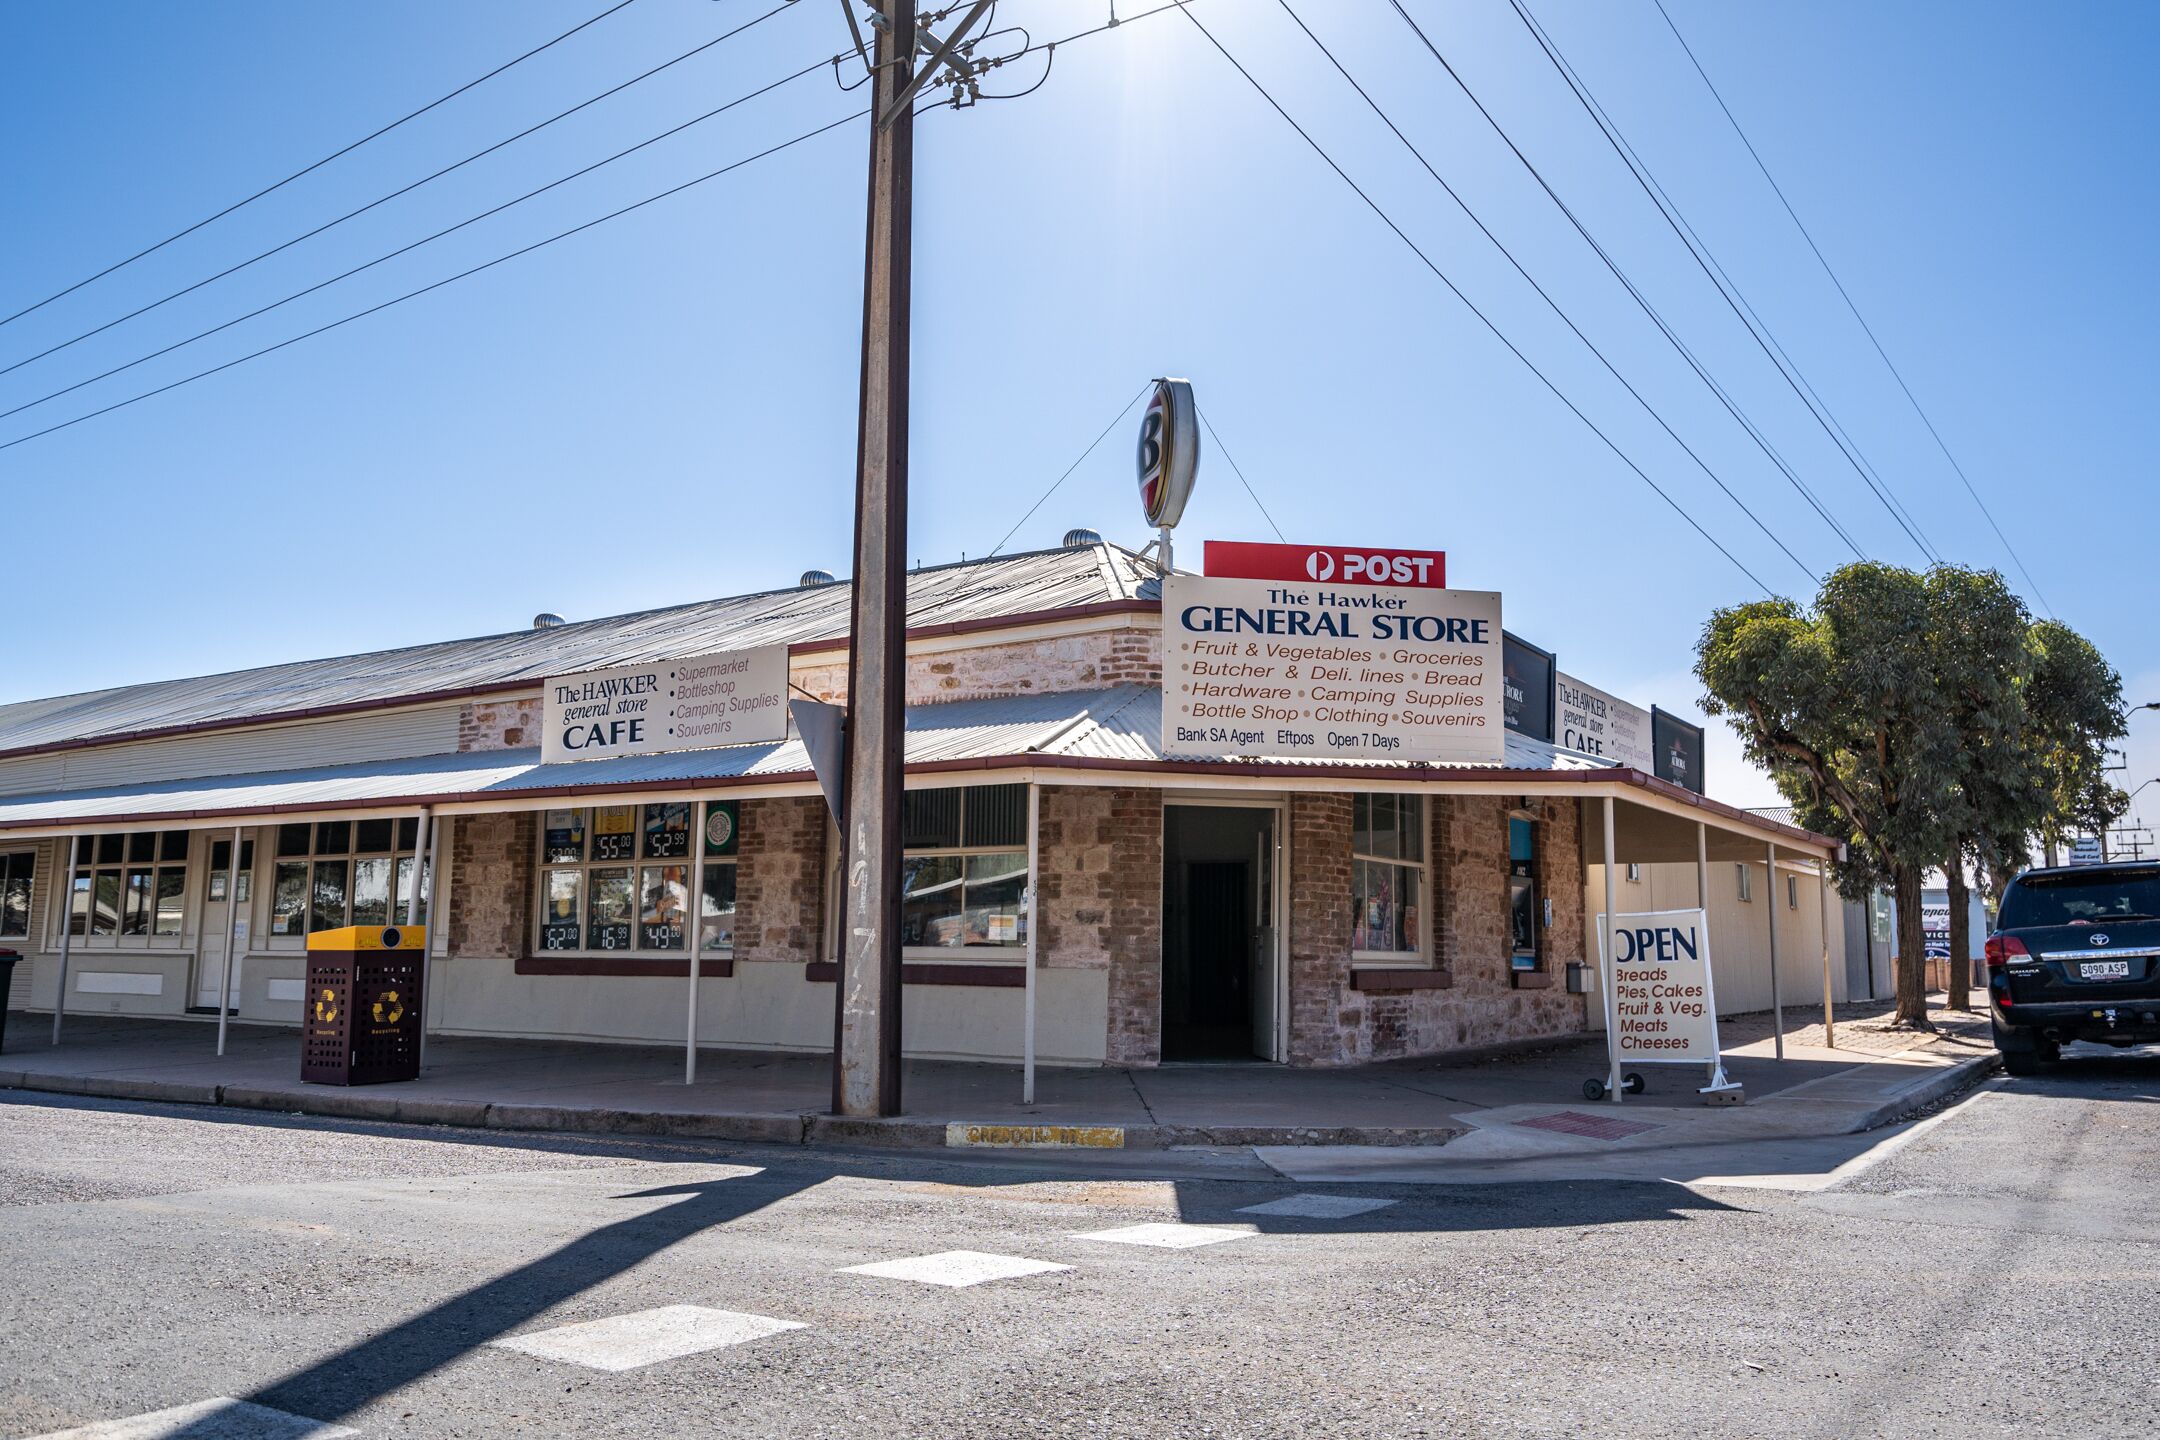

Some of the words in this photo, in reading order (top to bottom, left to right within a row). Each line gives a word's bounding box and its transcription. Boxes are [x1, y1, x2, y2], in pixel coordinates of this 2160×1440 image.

[1344, 554, 1434, 584] POST
[1266, 589, 1308, 606] The
[1318, 592, 1407, 610] Hawker
[1181, 606, 1359, 638] GENERAL
[1372, 614, 1488, 644] STORE
[1193, 640, 1239, 656] Fruit
[1246, 643, 1258, 657] &
[1266, 644, 1372, 663] Vegetables
[1394, 650, 1484, 666] Groceries
[678, 658, 749, 682] Supermarket
[1192, 661, 1274, 678] Butcher
[1286, 666, 1298, 680] &
[1311, 667, 1352, 682] Deli.
[1361, 669, 1404, 684] lines
[1424, 671, 1483, 686] Bread
[555, 686, 580, 704] The
[582, 674, 658, 701] HAWKER
[677, 680, 736, 700] Bottleshop
[1192, 682, 1291, 700] Hardware
[1311, 687, 1396, 706] Camping
[1406, 690, 1484, 708] Supplies
[676, 701, 725, 718] Camping
[729, 693, 779, 711] Supplies
[1558, 682, 1571, 704] The
[1572, 688, 1607, 720] HAWKER
[564, 698, 610, 726] general
[616, 698, 648, 714] store
[1192, 704, 1246, 719] Bottle
[1252, 705, 1298, 724] Shop
[1314, 708, 1388, 727] Clothing
[1402, 710, 1486, 727] Souvenirs
[1564, 709, 1586, 727] general
[1590, 717, 1603, 735] store
[562, 718, 644, 750] CAFE
[676, 719, 731, 738] Souvenirs
[1177, 727, 1207, 742] Bank
[1210, 728, 1227, 742] SA
[1230, 730, 1264, 746] Agent
[1278, 730, 1314, 746] Eftpos
[1328, 732, 1359, 748] Open
[1362, 733, 1368, 746] 7
[1372, 733, 1400, 749] Days
[597, 836, 630, 858] $55.00
[650, 833, 684, 856] $52.99
[545, 928, 577, 950] $62.00
[1616, 927, 1697, 962] OPEN
[1617, 968, 1667, 981] Breads
[1617, 985, 1648, 1000] Pies,
[1652, 984, 1702, 997] Cakes
[1618, 1002, 1649, 1015] Fruit
[1654, 1002, 1664, 1014] &
[1670, 1001, 1706, 1017] Veg.
[1620, 1019, 1668, 1032] Meats
[1621, 1036, 1689, 1048] Cheeses
